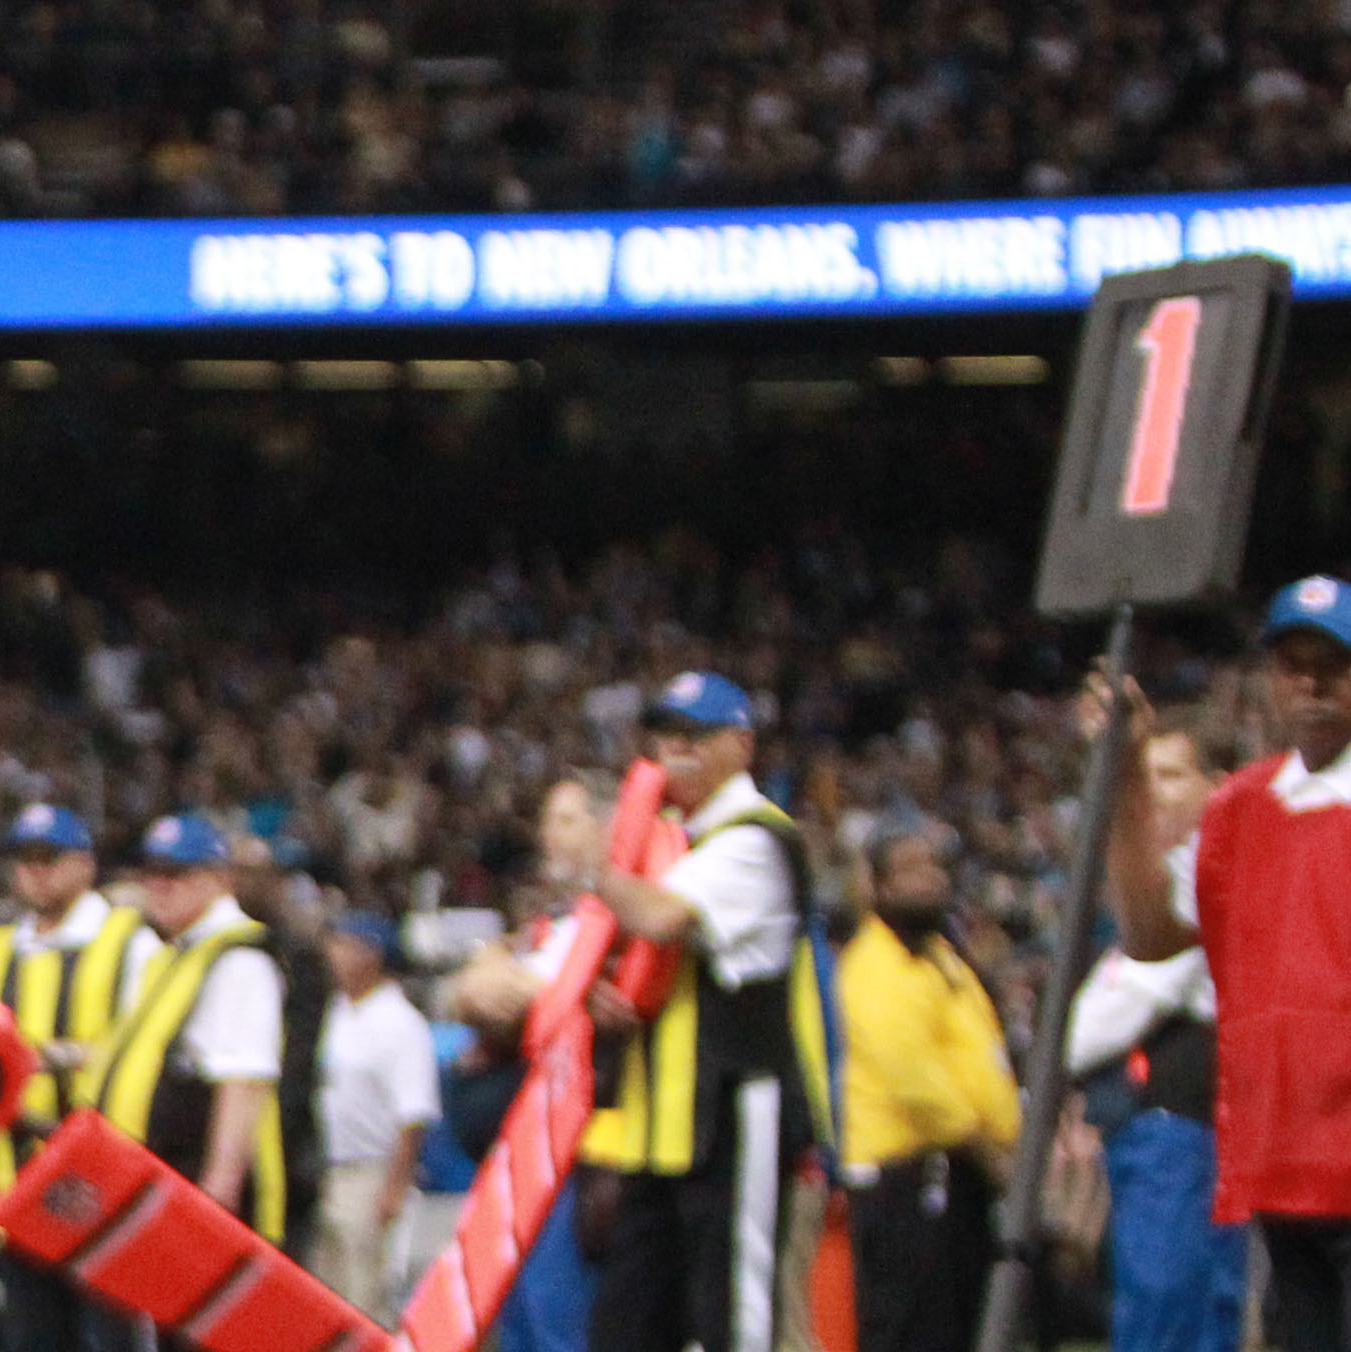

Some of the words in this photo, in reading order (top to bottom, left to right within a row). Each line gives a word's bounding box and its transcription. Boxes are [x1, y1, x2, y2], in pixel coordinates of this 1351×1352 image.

[195, 235, 389, 307] HERE'S
[394, 232, 474, 303] TO
[485, 230, 612, 301] NEW
[881, 218, 1065, 292] WHERE
[1122, 295, 1202, 517] 1
